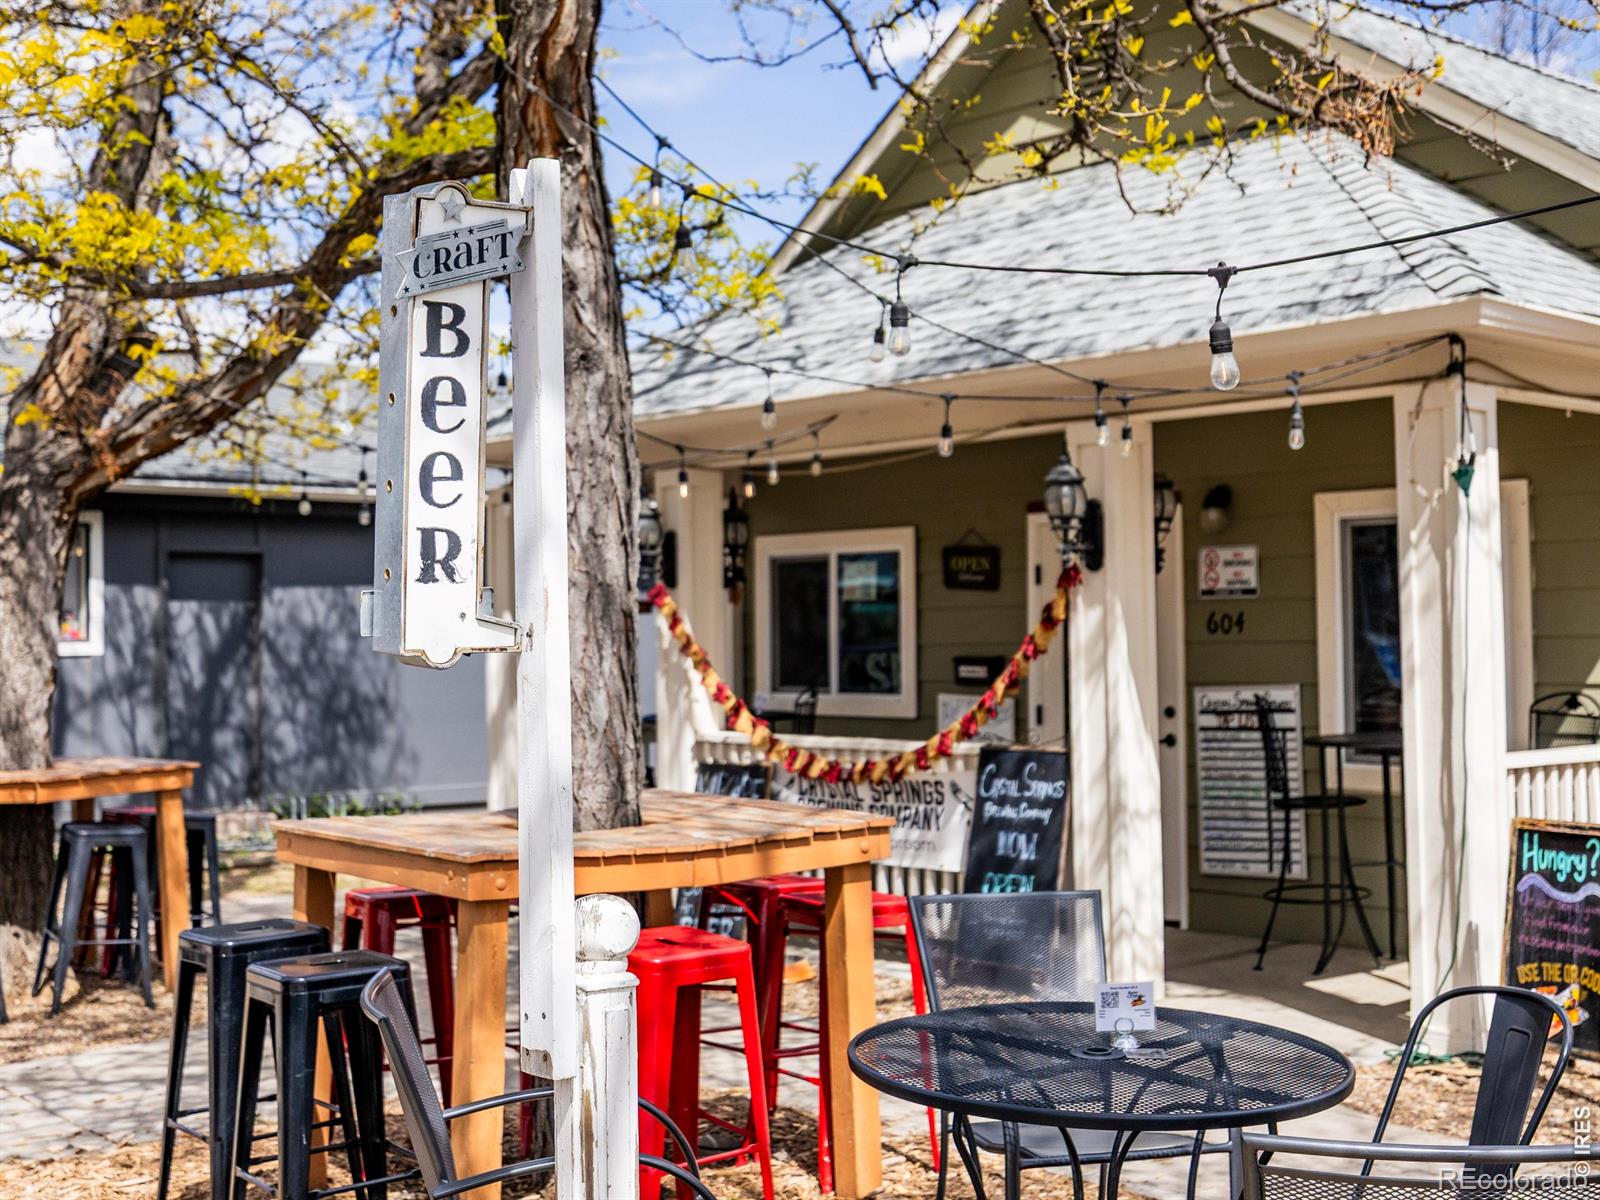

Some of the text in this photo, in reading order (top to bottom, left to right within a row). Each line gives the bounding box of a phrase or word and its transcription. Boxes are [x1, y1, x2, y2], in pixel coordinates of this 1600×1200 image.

[1206, 611, 1244, 635] 604
[870, 778, 945, 806] SPRINGS
[996, 831, 1038, 860] NOW
[1522, 832, 1600, 882] Hungry?
[981, 871, 1036, 893] OPEN
[1517, 962, 1541, 984] USE
[1541, 961, 1562, 983] THE
